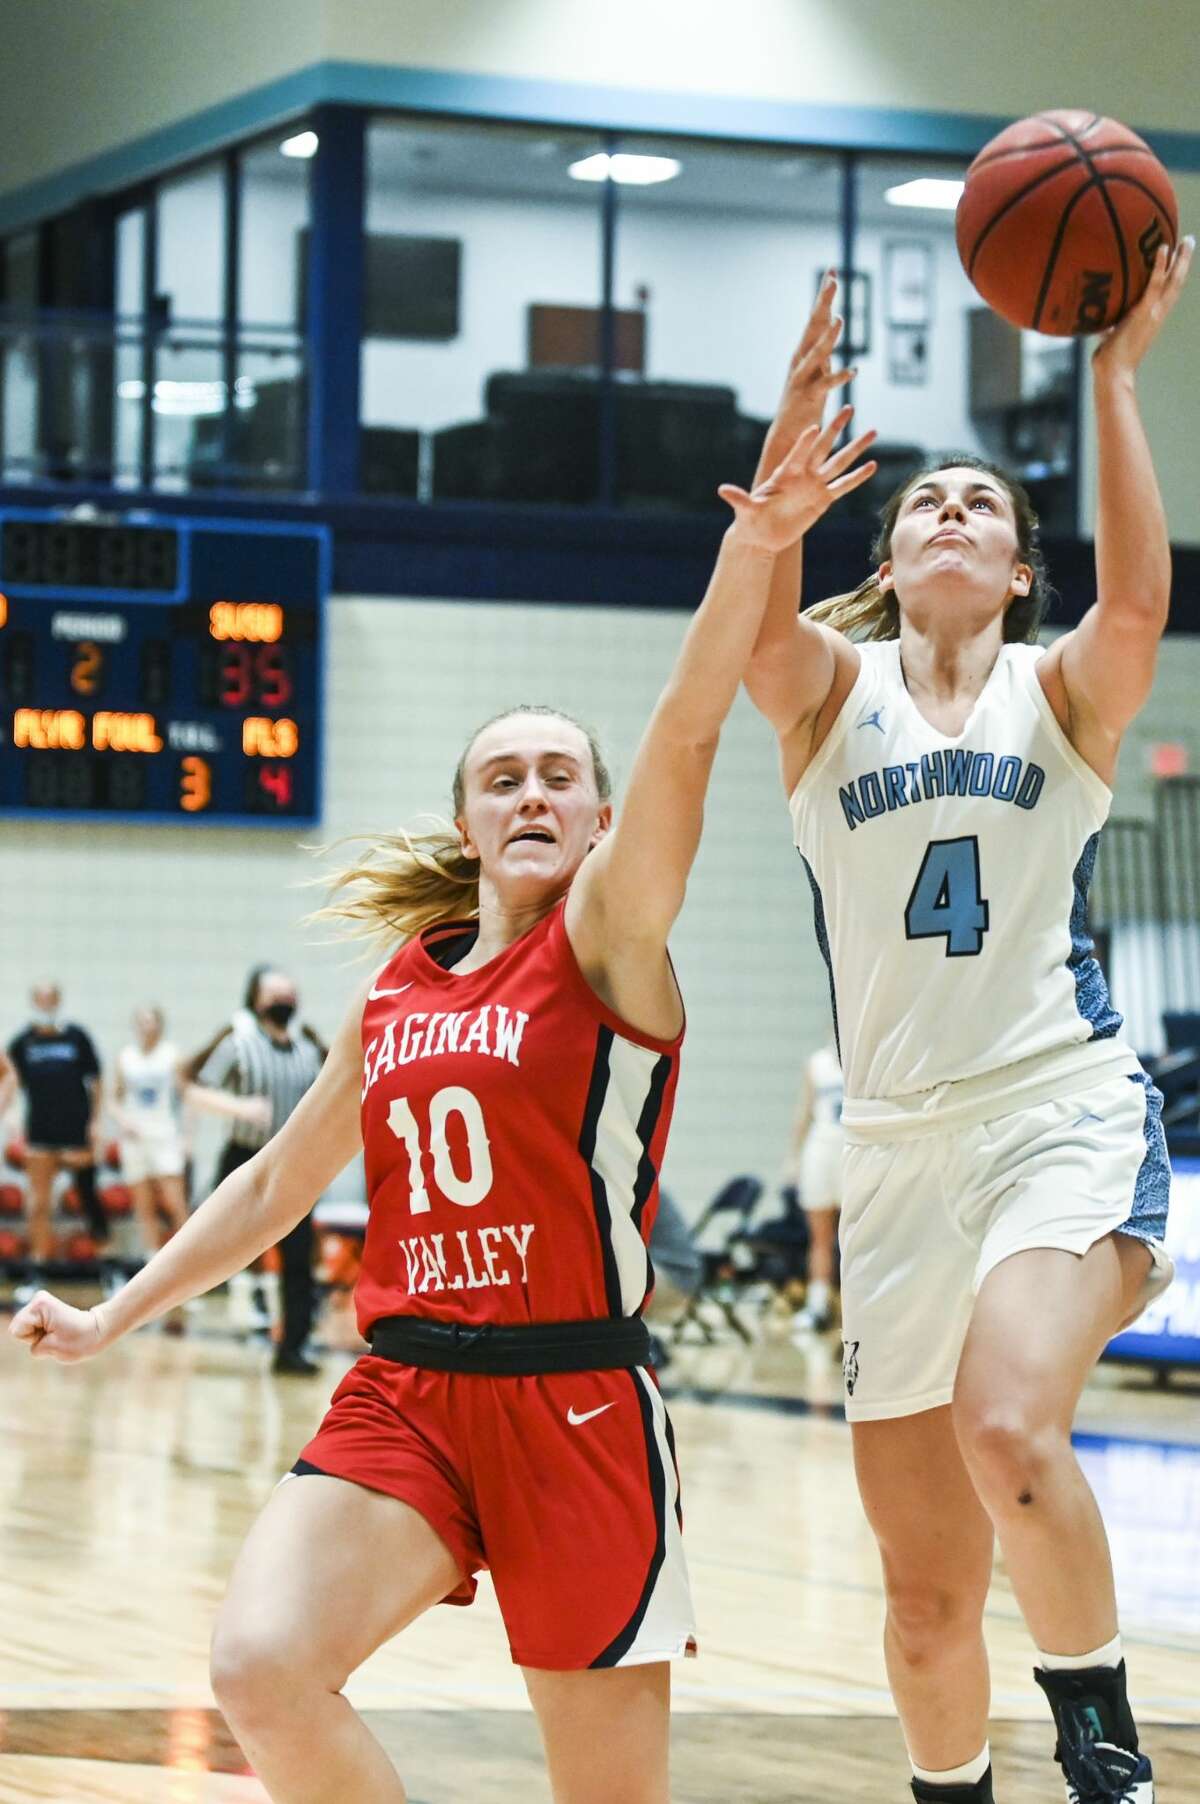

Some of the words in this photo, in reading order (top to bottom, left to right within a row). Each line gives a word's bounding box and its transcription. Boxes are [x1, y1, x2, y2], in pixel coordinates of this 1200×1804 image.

[71, 642, 102, 694] 2
[222, 643, 292, 705] 35
[180, 756, 211, 811] 3
[259, 766, 292, 804] 4
[839, 750, 1045, 831] NORTHWOOD
[905, 835, 989, 957] 4
[361, 1004, 529, 1104] SAGINAW
[387, 1086, 493, 1215] 10
[399, 1224, 534, 1295] VALLEY
